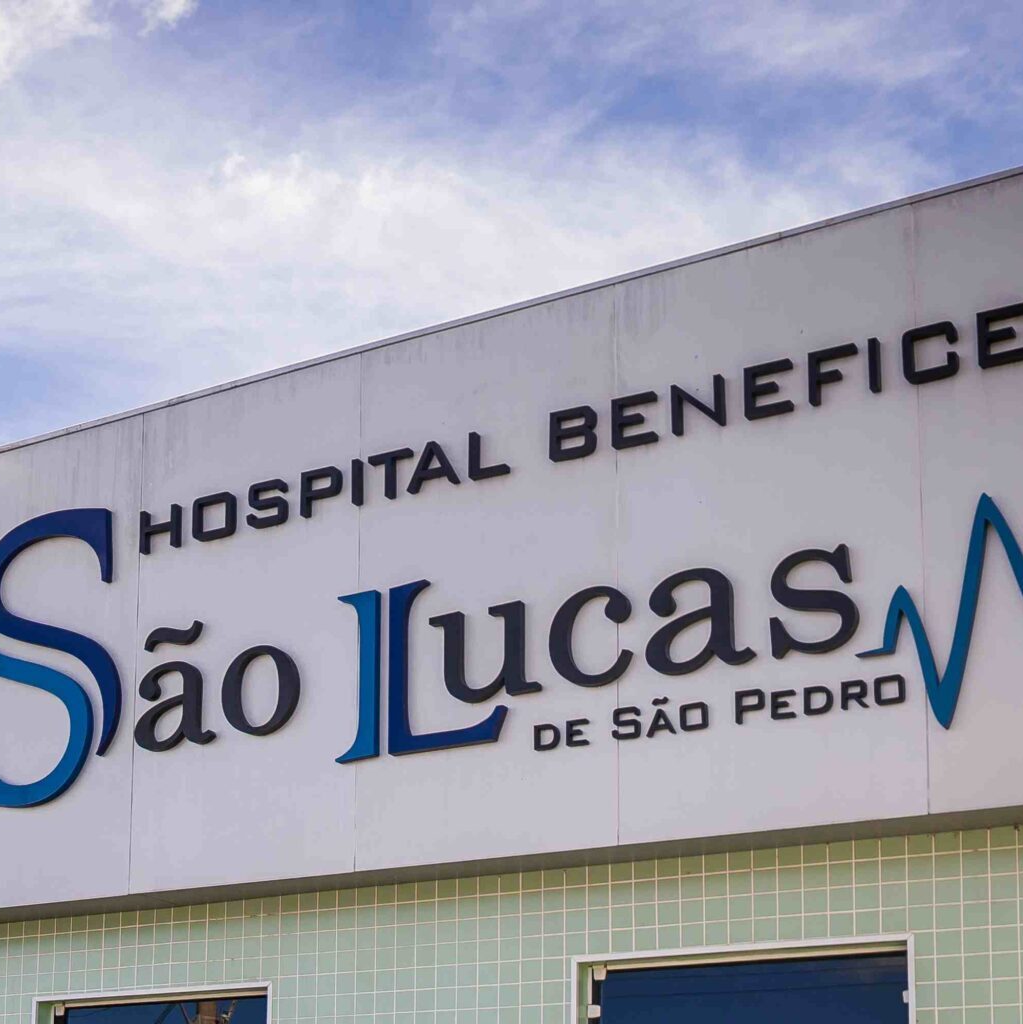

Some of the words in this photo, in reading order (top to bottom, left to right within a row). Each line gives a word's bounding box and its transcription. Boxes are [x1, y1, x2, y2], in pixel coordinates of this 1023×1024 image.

[138, 431, 511, 556] HOSPITAL
[334, 543, 862, 765] Lucas
[533, 718, 590, 752] DE
[611, 696, 709, 741] SÃO
[734, 674, 906, 725] PEDRO
